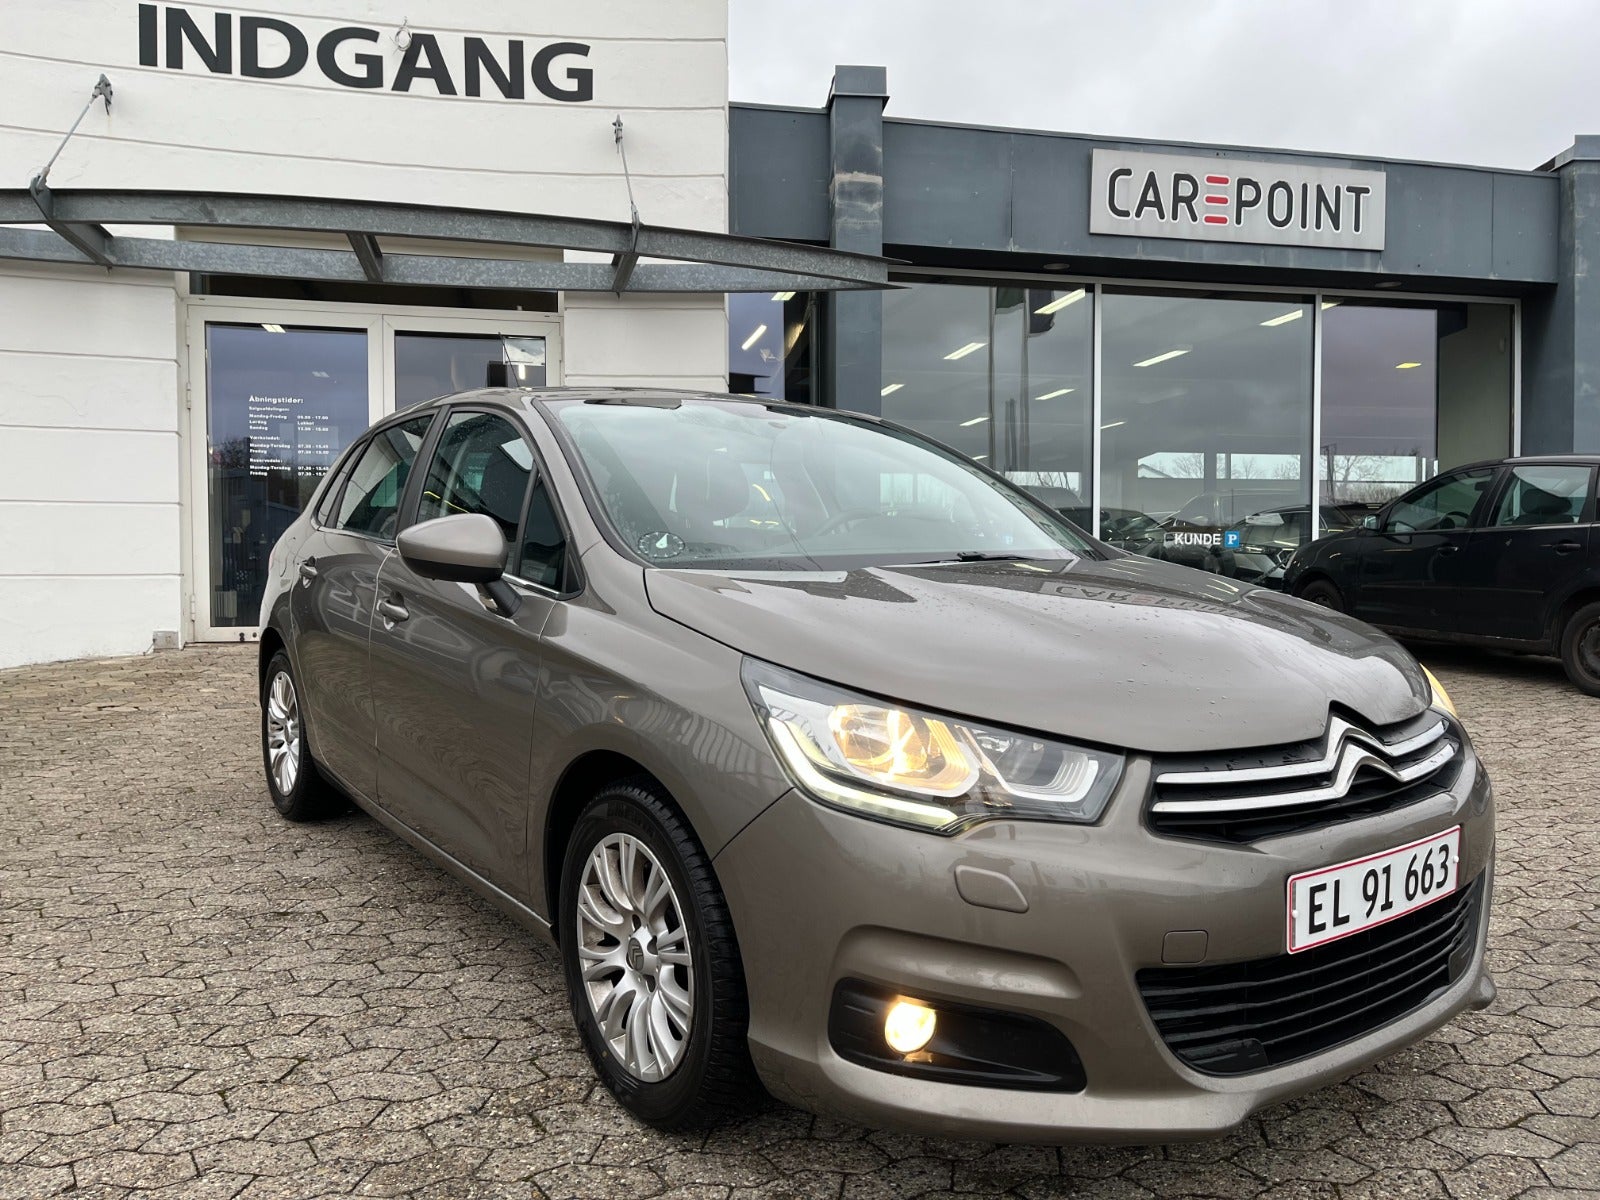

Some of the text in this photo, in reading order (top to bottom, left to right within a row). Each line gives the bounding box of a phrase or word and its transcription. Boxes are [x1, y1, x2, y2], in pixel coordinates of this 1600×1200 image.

[138, 3, 594, 102] INDGANG
[1107, 167, 1372, 234] CAREPOINT
[1174, 533, 1237, 545] KUNDE P
[1309, 844, 1449, 934] EL 91 663
